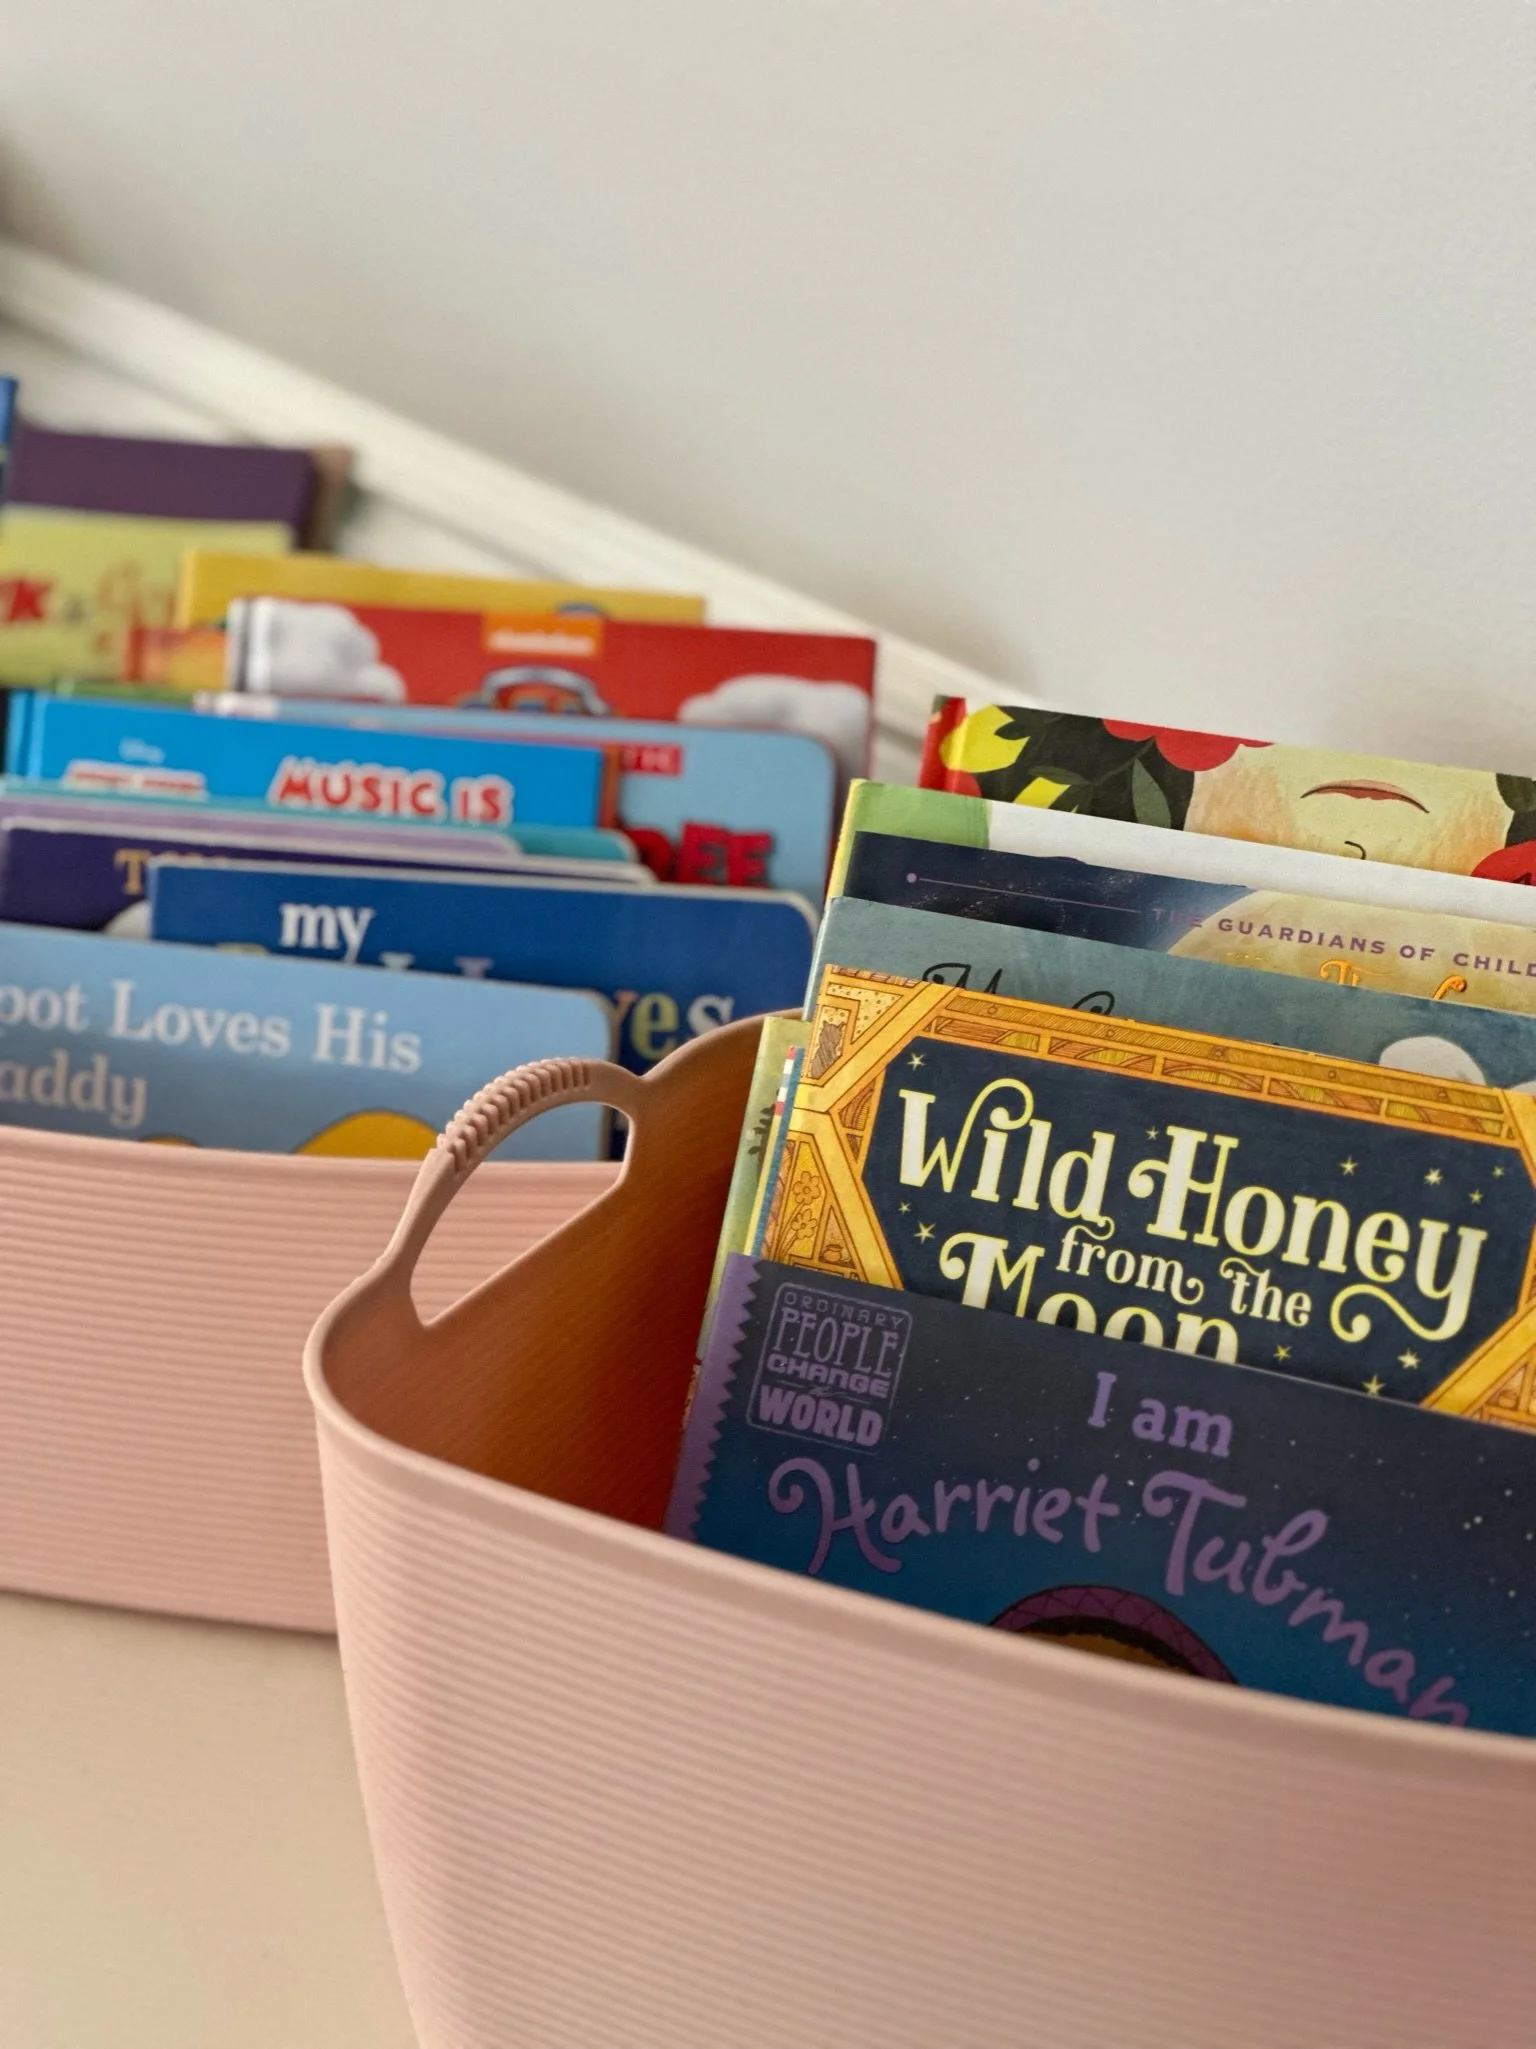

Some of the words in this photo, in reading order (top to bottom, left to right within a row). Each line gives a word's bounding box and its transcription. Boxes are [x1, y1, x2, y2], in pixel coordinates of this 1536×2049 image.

[276, 770, 440, 818] MUSIC
[460, 784, 502, 822] IS
[279, 903, 375, 964] my
[1218, 918, 1385, 955] GUARDIANS
[1399, 943, 1435, 962] OF
[109, 979, 291, 1058] Loves
[312, 1003, 422, 1074] His
[898, 1078, 1115, 1241] Wild
[1127, 1125, 1488, 1343] Honey
[1056, 1224, 1205, 1305] from
[1219, 1257, 1312, 1327] the
[772, 1306, 899, 1379] PEOPLE
[783, 1291, 904, 1329] ORDINARY
[767, 1352, 890, 1399] CHANGE
[759, 1384, 884, 1447] WORLD
[1087, 1371, 1117, 1428] I
[1131, 1398, 1233, 1459] am
[768, 1456, 1122, 1576] Harriet
[1142, 1469, 1472, 1731] Tubman
